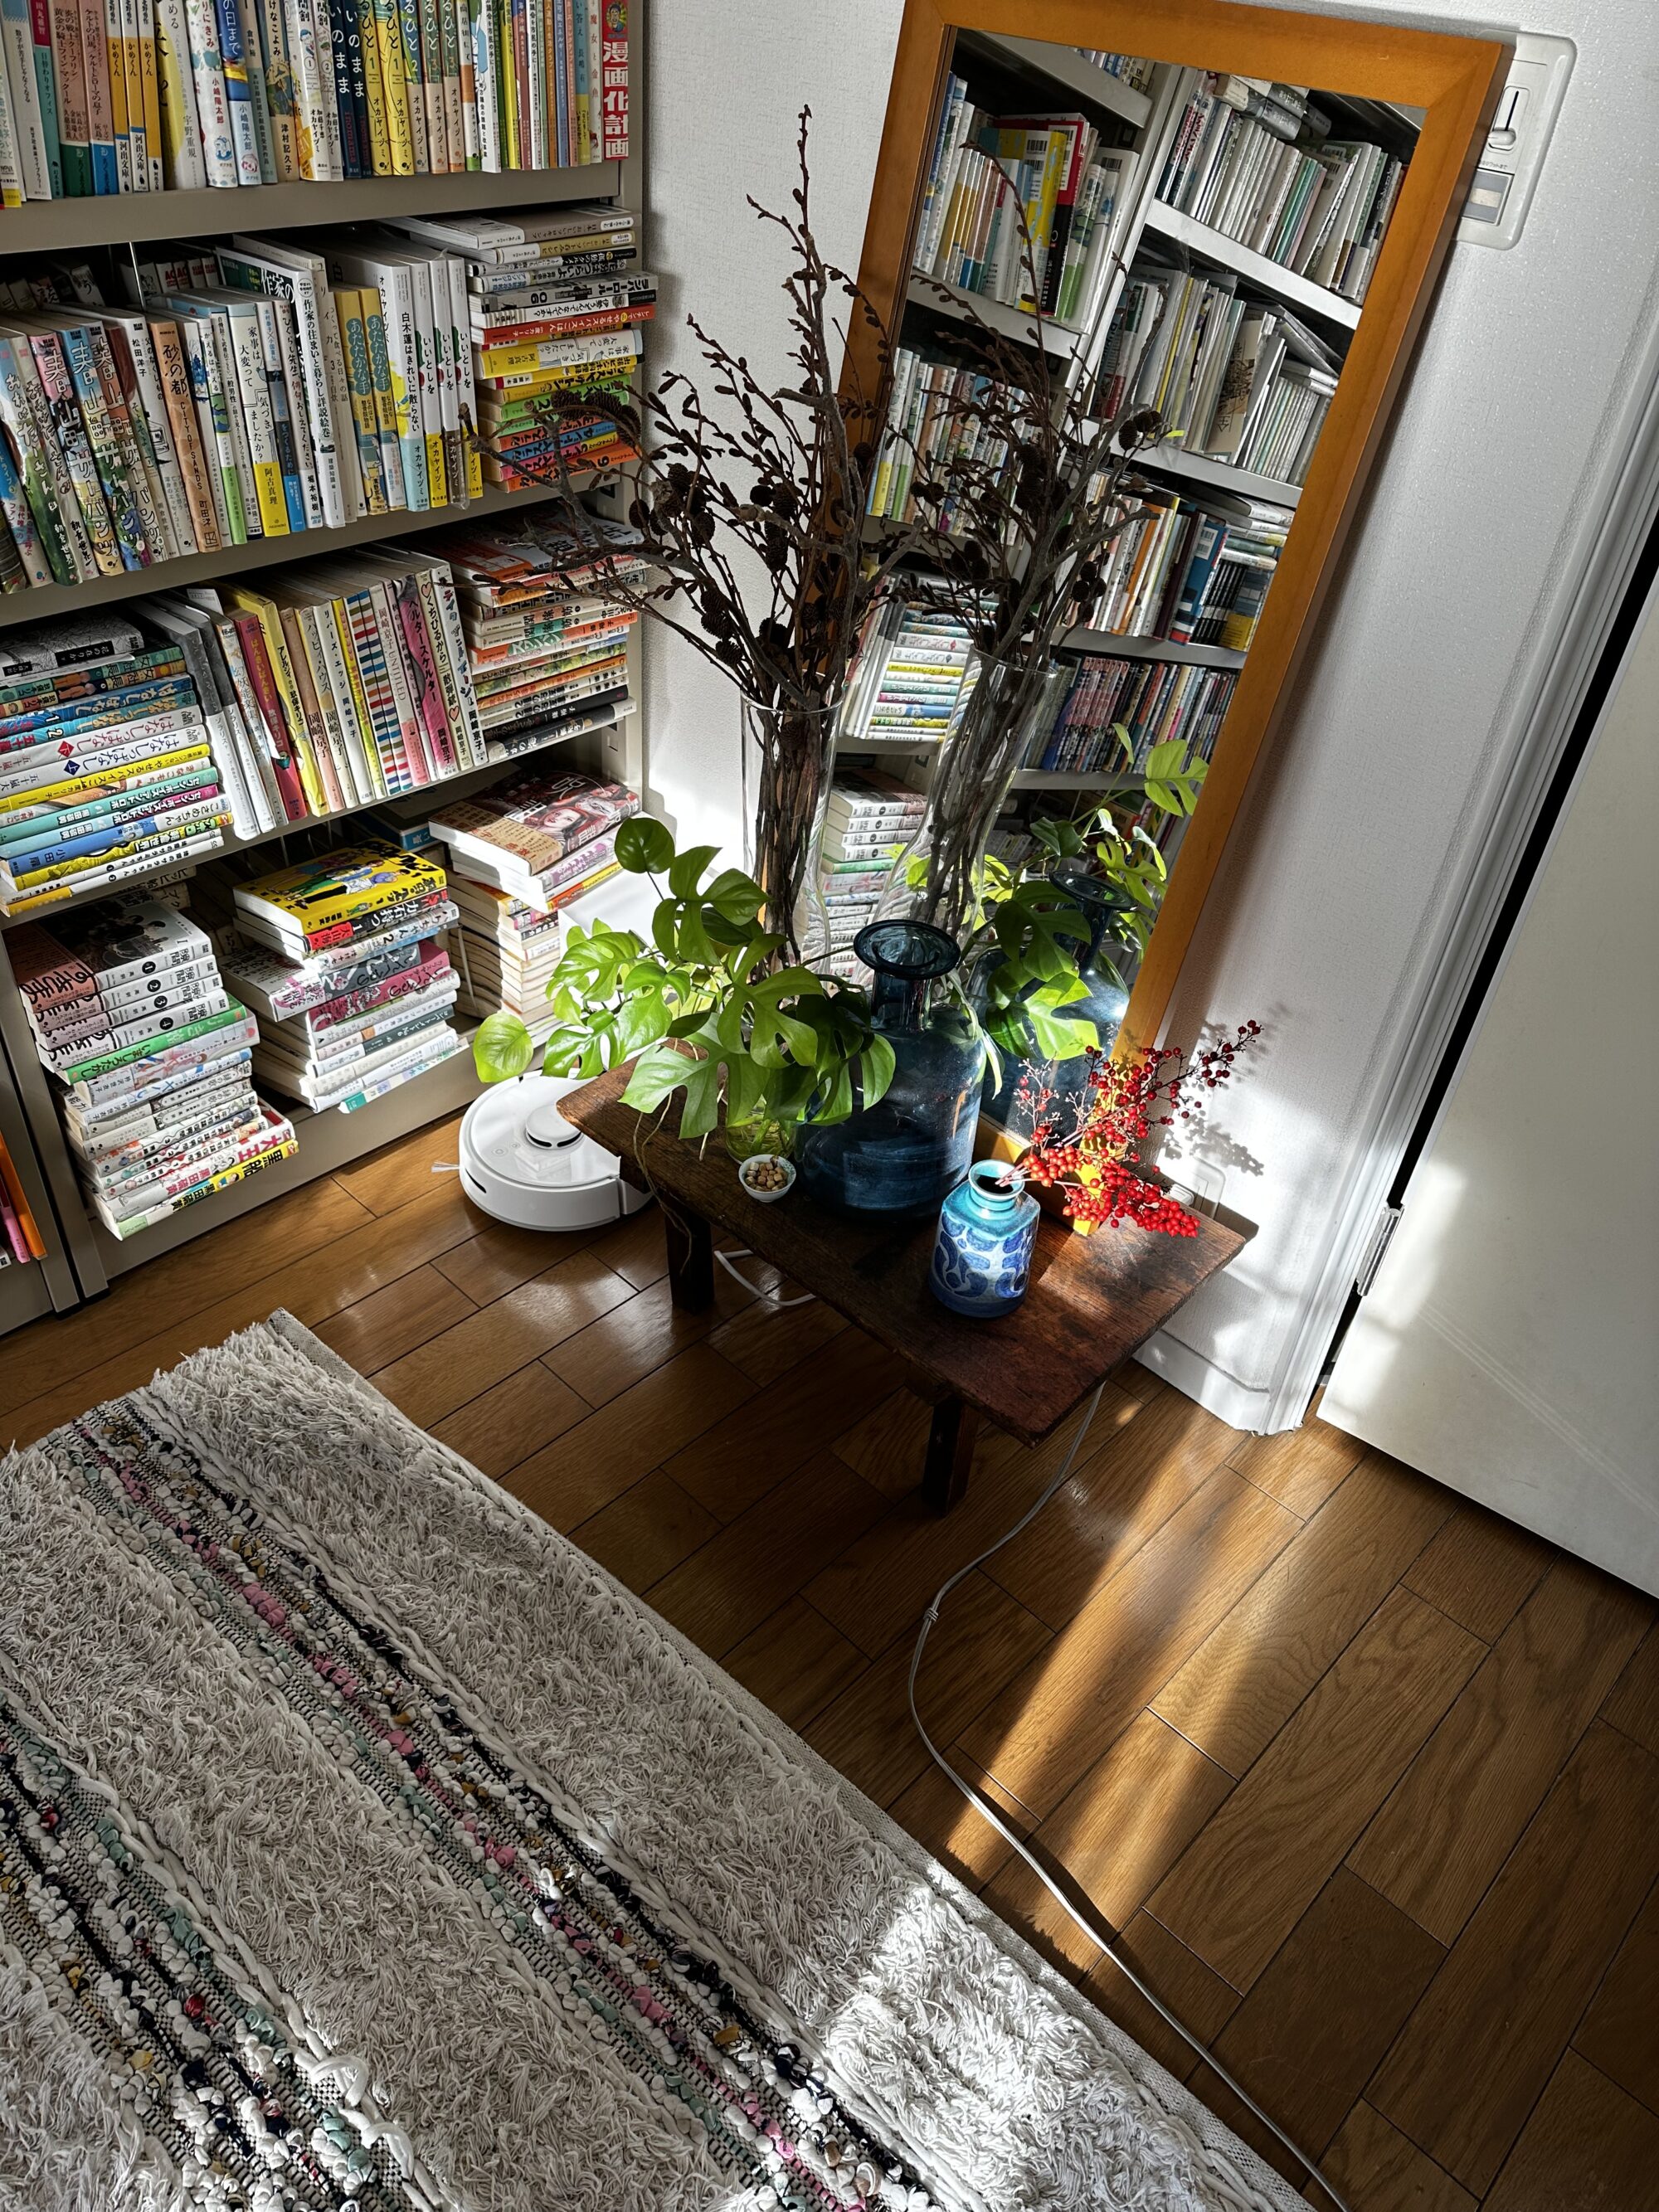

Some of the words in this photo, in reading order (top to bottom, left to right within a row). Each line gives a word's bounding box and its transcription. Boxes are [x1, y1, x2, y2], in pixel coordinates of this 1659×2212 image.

[404, 1, 419, 51] るひと
[111, 41, 121, 77] かめくん
[128, 41, 137, 77] かめくん
[144, 41, 154, 77] かめくん
[330, 6, 351, 94] いのまま
[346, 10, 364, 98] いのまま
[369, 57, 376, 70] 1
[393, 57, 400, 70] 1
[411, 61, 418, 72] 2
[431, 58, 438, 70] 3
[212, 78, 224, 124] 小嶋陽太郎
[603, 41, 629, 158] 漫画化計画
[183, 114, 197, 158] 宇野重規
[239, 104, 253, 151] 小嶋陽太郎
[310, 110, 320, 153] オカヤイヅミ
[373, 97, 387, 158] オカヤイヅミ
[396, 98, 411, 158] オカヤイヅミ
[413, 95, 424, 158] オカヤイヅミ
[435, 95, 444, 156] オカヤイヅミ
[119, 141, 129, 177] 河出文庫
[134, 135, 145, 171] 河出文庫
[280, 124, 293, 173] 津村記久子
[132, 338, 147, 377] 松田洋子
[247, 325, 262, 360] 家事は
[349, 319, 370, 396] あたたかな手
[370, 316, 390, 393] あたたかな手
[442, 333, 455, 391] いいとしを
[460, 333, 471, 389] いいとしを
[507, 352, 536, 365] 阿古真理
[162, 343, 188, 398] 砂の都
[239, 343, 254, 388] 大変って
[304, 299, 331, 438] 作家の住まいと暮らし詳説絵巻
[401, 312, 420, 433] 白木蓮はきれいに散らない
[424, 337, 435, 395] いいとしを
[260, 396, 273, 431] 気づき
[180, 401, 190, 430] CITY
[190, 451, 202, 490] SANDS
[251, 409, 265, 464] ましたか?
[264, 467, 279, 505] 阿古真理
[415, 445, 426, 496] オカヤイヅミ
[432, 441, 442, 491] オカヤイヅミ
[307, 474, 319, 512] 堀本裕樹
[199, 500, 212, 527] 町田洋
[324, 609, 345, 690] リバーズ・エッジ
[427, 595, 446, 664] くちびるから
[378, 608, 395, 650] 岡崎京子
[389, 651, 406, 702] UNTITLED
[408, 599, 437, 702] ヘルタースケルター
[47, 727, 65, 740] 2
[76, 713, 175, 752] はなしっぱなし
[307, 713, 327, 759] 岡崎京子
[324, 711, 343, 756] 岡崎京子
[343, 698, 358, 738] 岡崎京子
[469, 710, 483, 751] 岡崎京子
[82, 732, 180, 771] はなしっぱなし
[437, 727, 453, 764] 岡崎京子
[455, 726, 467, 756] 岡崎京子
[56, 808, 91, 826] 黒田硫黄
[59, 823, 94, 841] 黒田硫黄
[165, 801, 220, 827] こさめちゃん
[29, 848, 66, 868] 小田扉
[319, 926, 348, 944] 大山海
[383, 933, 395, 945] 2
[80, 1043, 151, 1077] いましろたかし
[236, 1134, 283, 1163] 大王
[243, 1149, 284, 1179] 黒船
[165, 1168, 212, 1195] 黒田硫黄
[171, 1184, 216, 1212] 黒田硫黄
